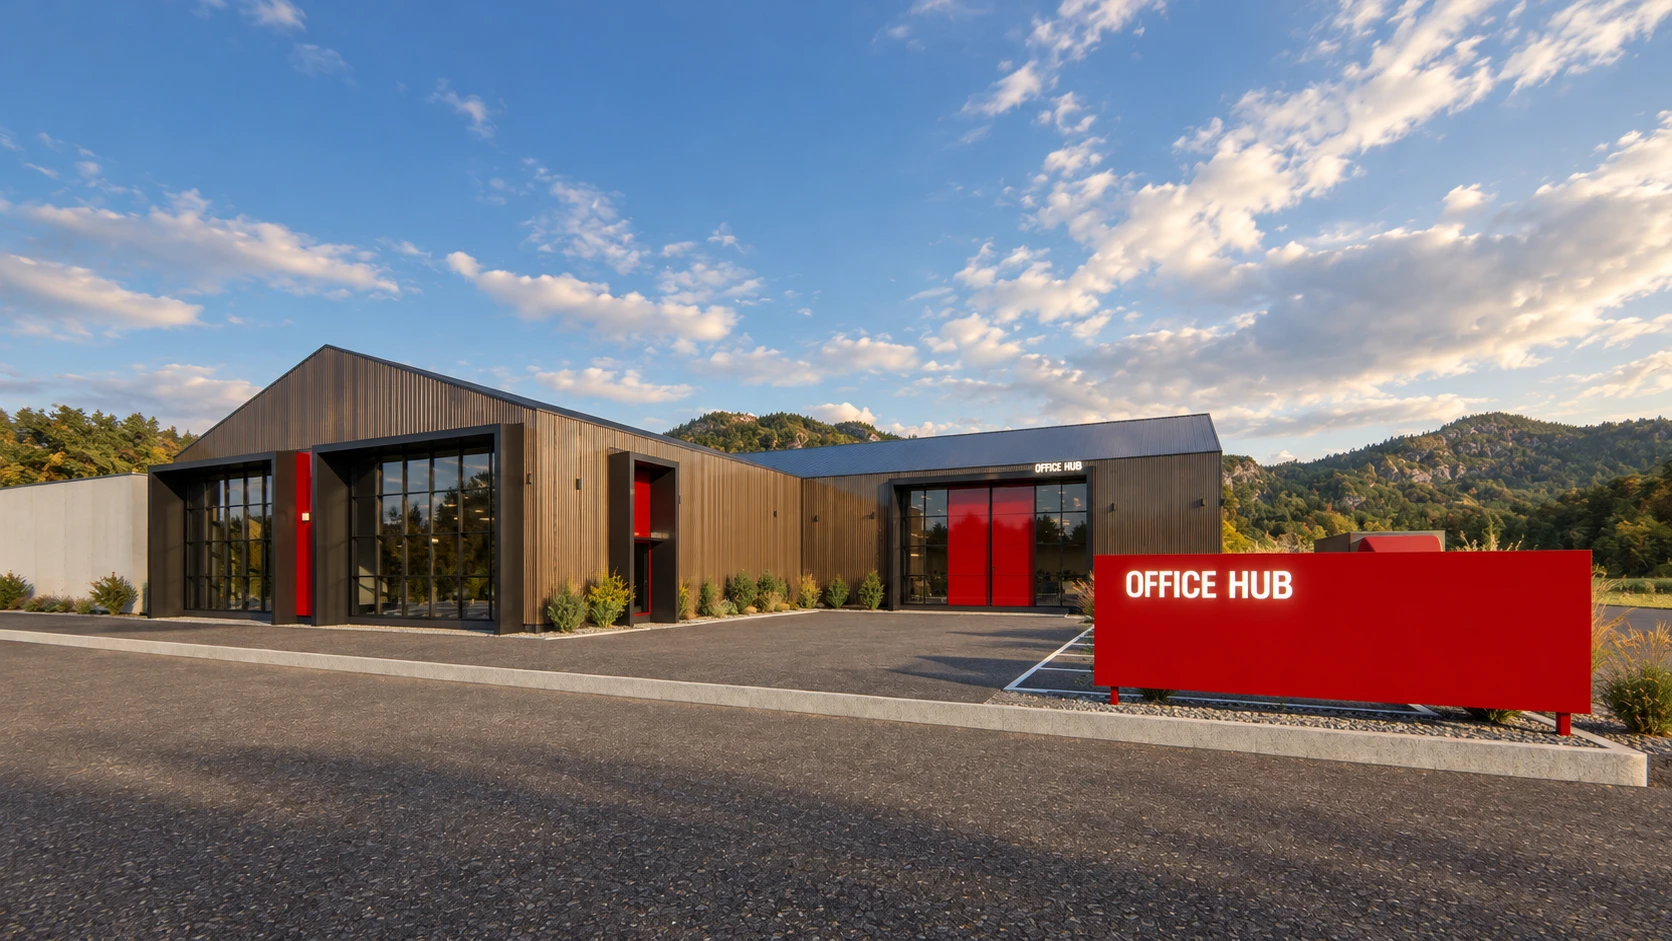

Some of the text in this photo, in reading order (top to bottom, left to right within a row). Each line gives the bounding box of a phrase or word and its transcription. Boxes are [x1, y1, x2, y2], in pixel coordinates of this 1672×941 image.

[1034, 461, 1082, 473] OFFICE HUB
[1126, 570, 1293, 600] OFFICE HUB
